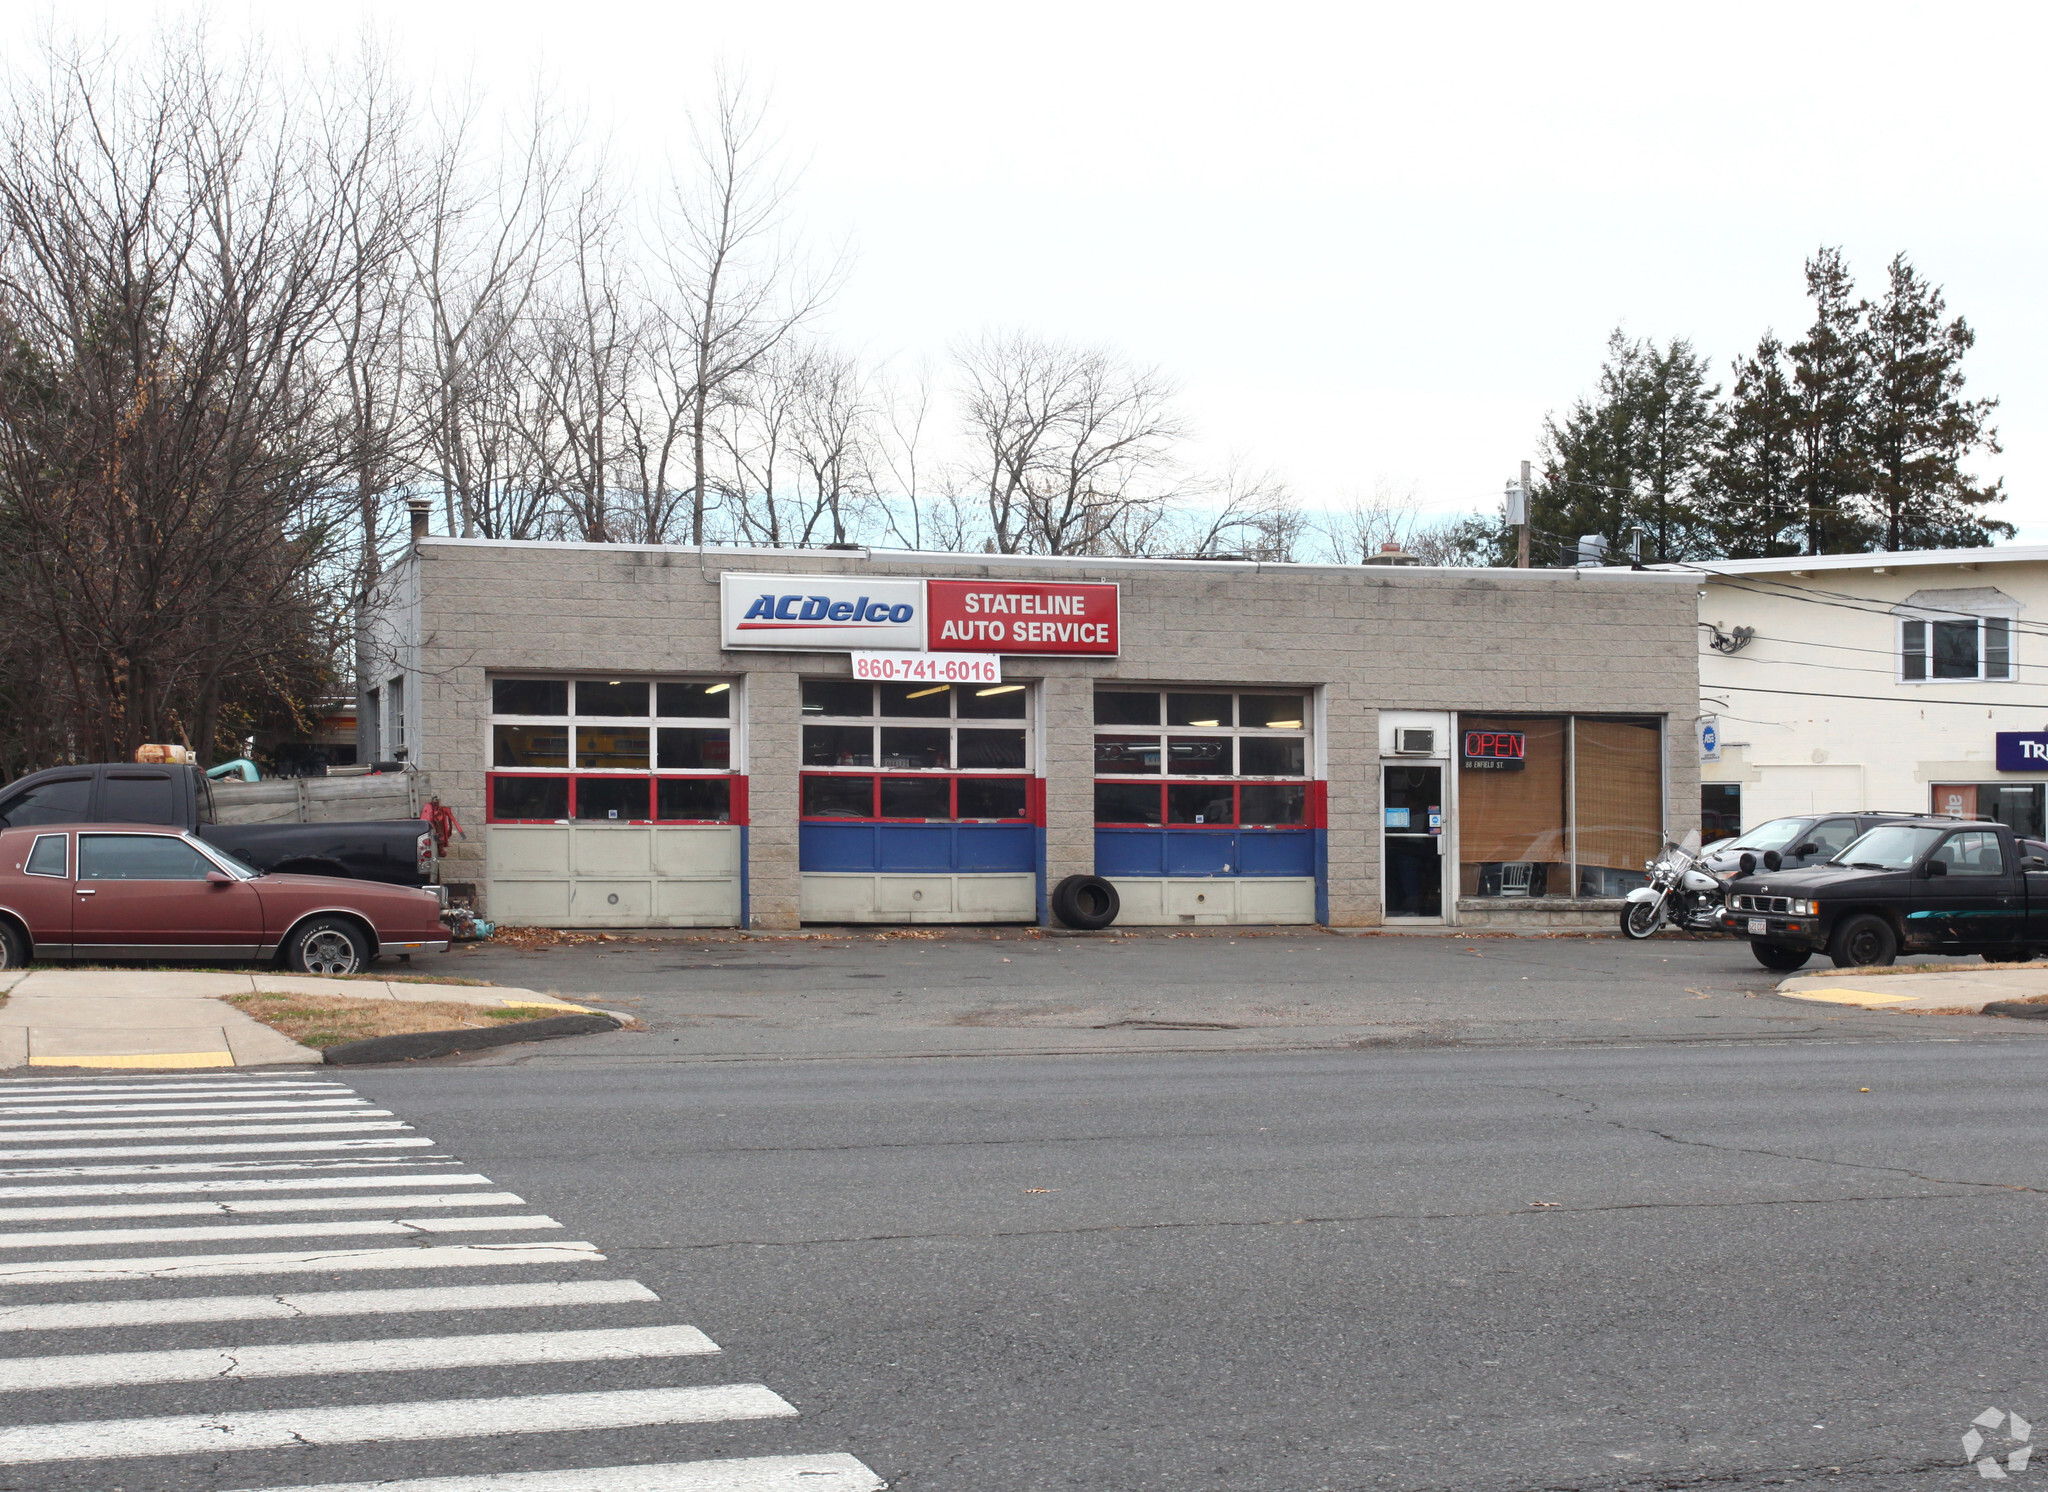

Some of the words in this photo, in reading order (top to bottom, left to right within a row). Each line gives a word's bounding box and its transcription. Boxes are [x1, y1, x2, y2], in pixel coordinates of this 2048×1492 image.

[744, 595, 914, 623] ACDelco
[965, 593, 1085, 615] STATELINE
[941, 620, 1005, 641] AUTO
[1012, 621, 1109, 643] SERVICE
[857, 658, 995, 681] 860-741-6016
[1467, 733, 1524, 758] OPEN
[1474, 761, 1495, 769] ENFIELD
